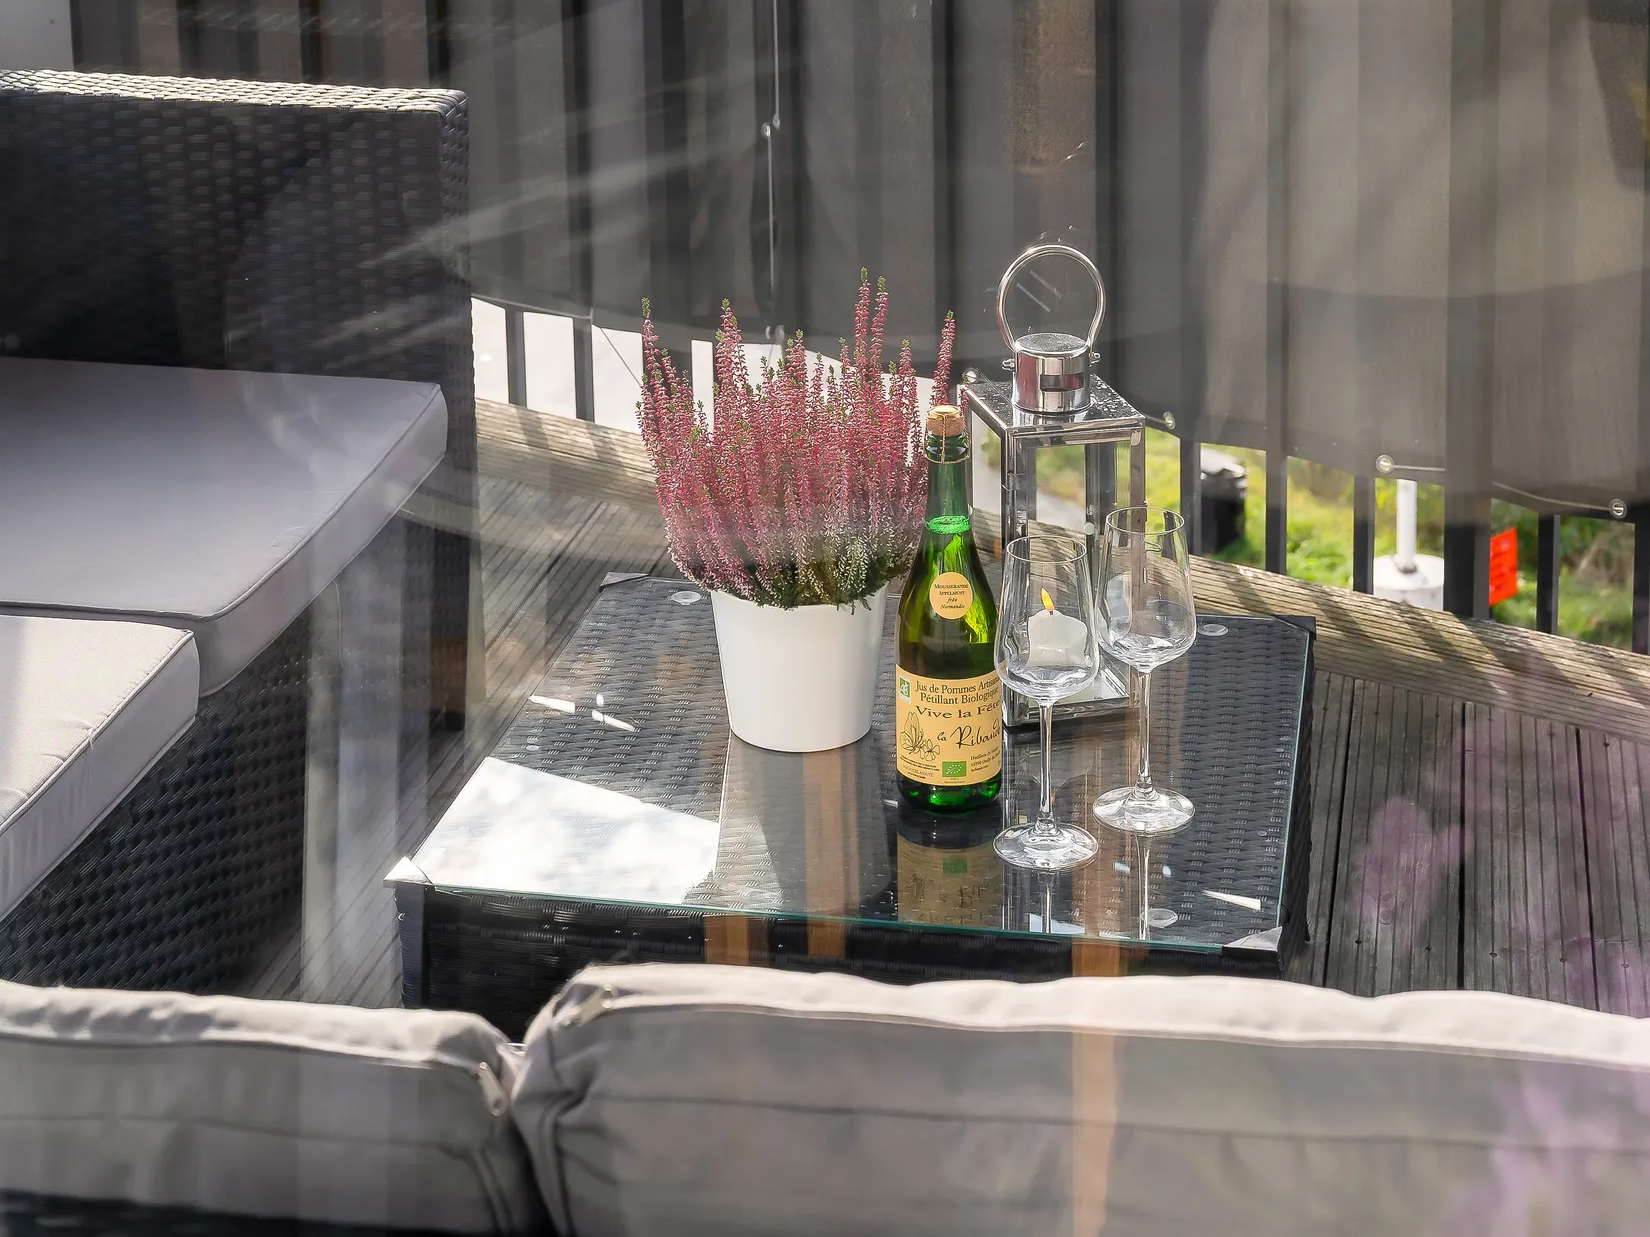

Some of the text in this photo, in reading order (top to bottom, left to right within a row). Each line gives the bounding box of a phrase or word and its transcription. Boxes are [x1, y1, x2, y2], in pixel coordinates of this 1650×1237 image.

[915, 680, 928, 692] Jus
[929, 683, 940, 694] de
[941, 684, 977, 695] Pommes
[920, 686, 999, 705] Pétillant Biologique
[915, 705, 953, 719] Vive
[957, 709, 973, 719] la
